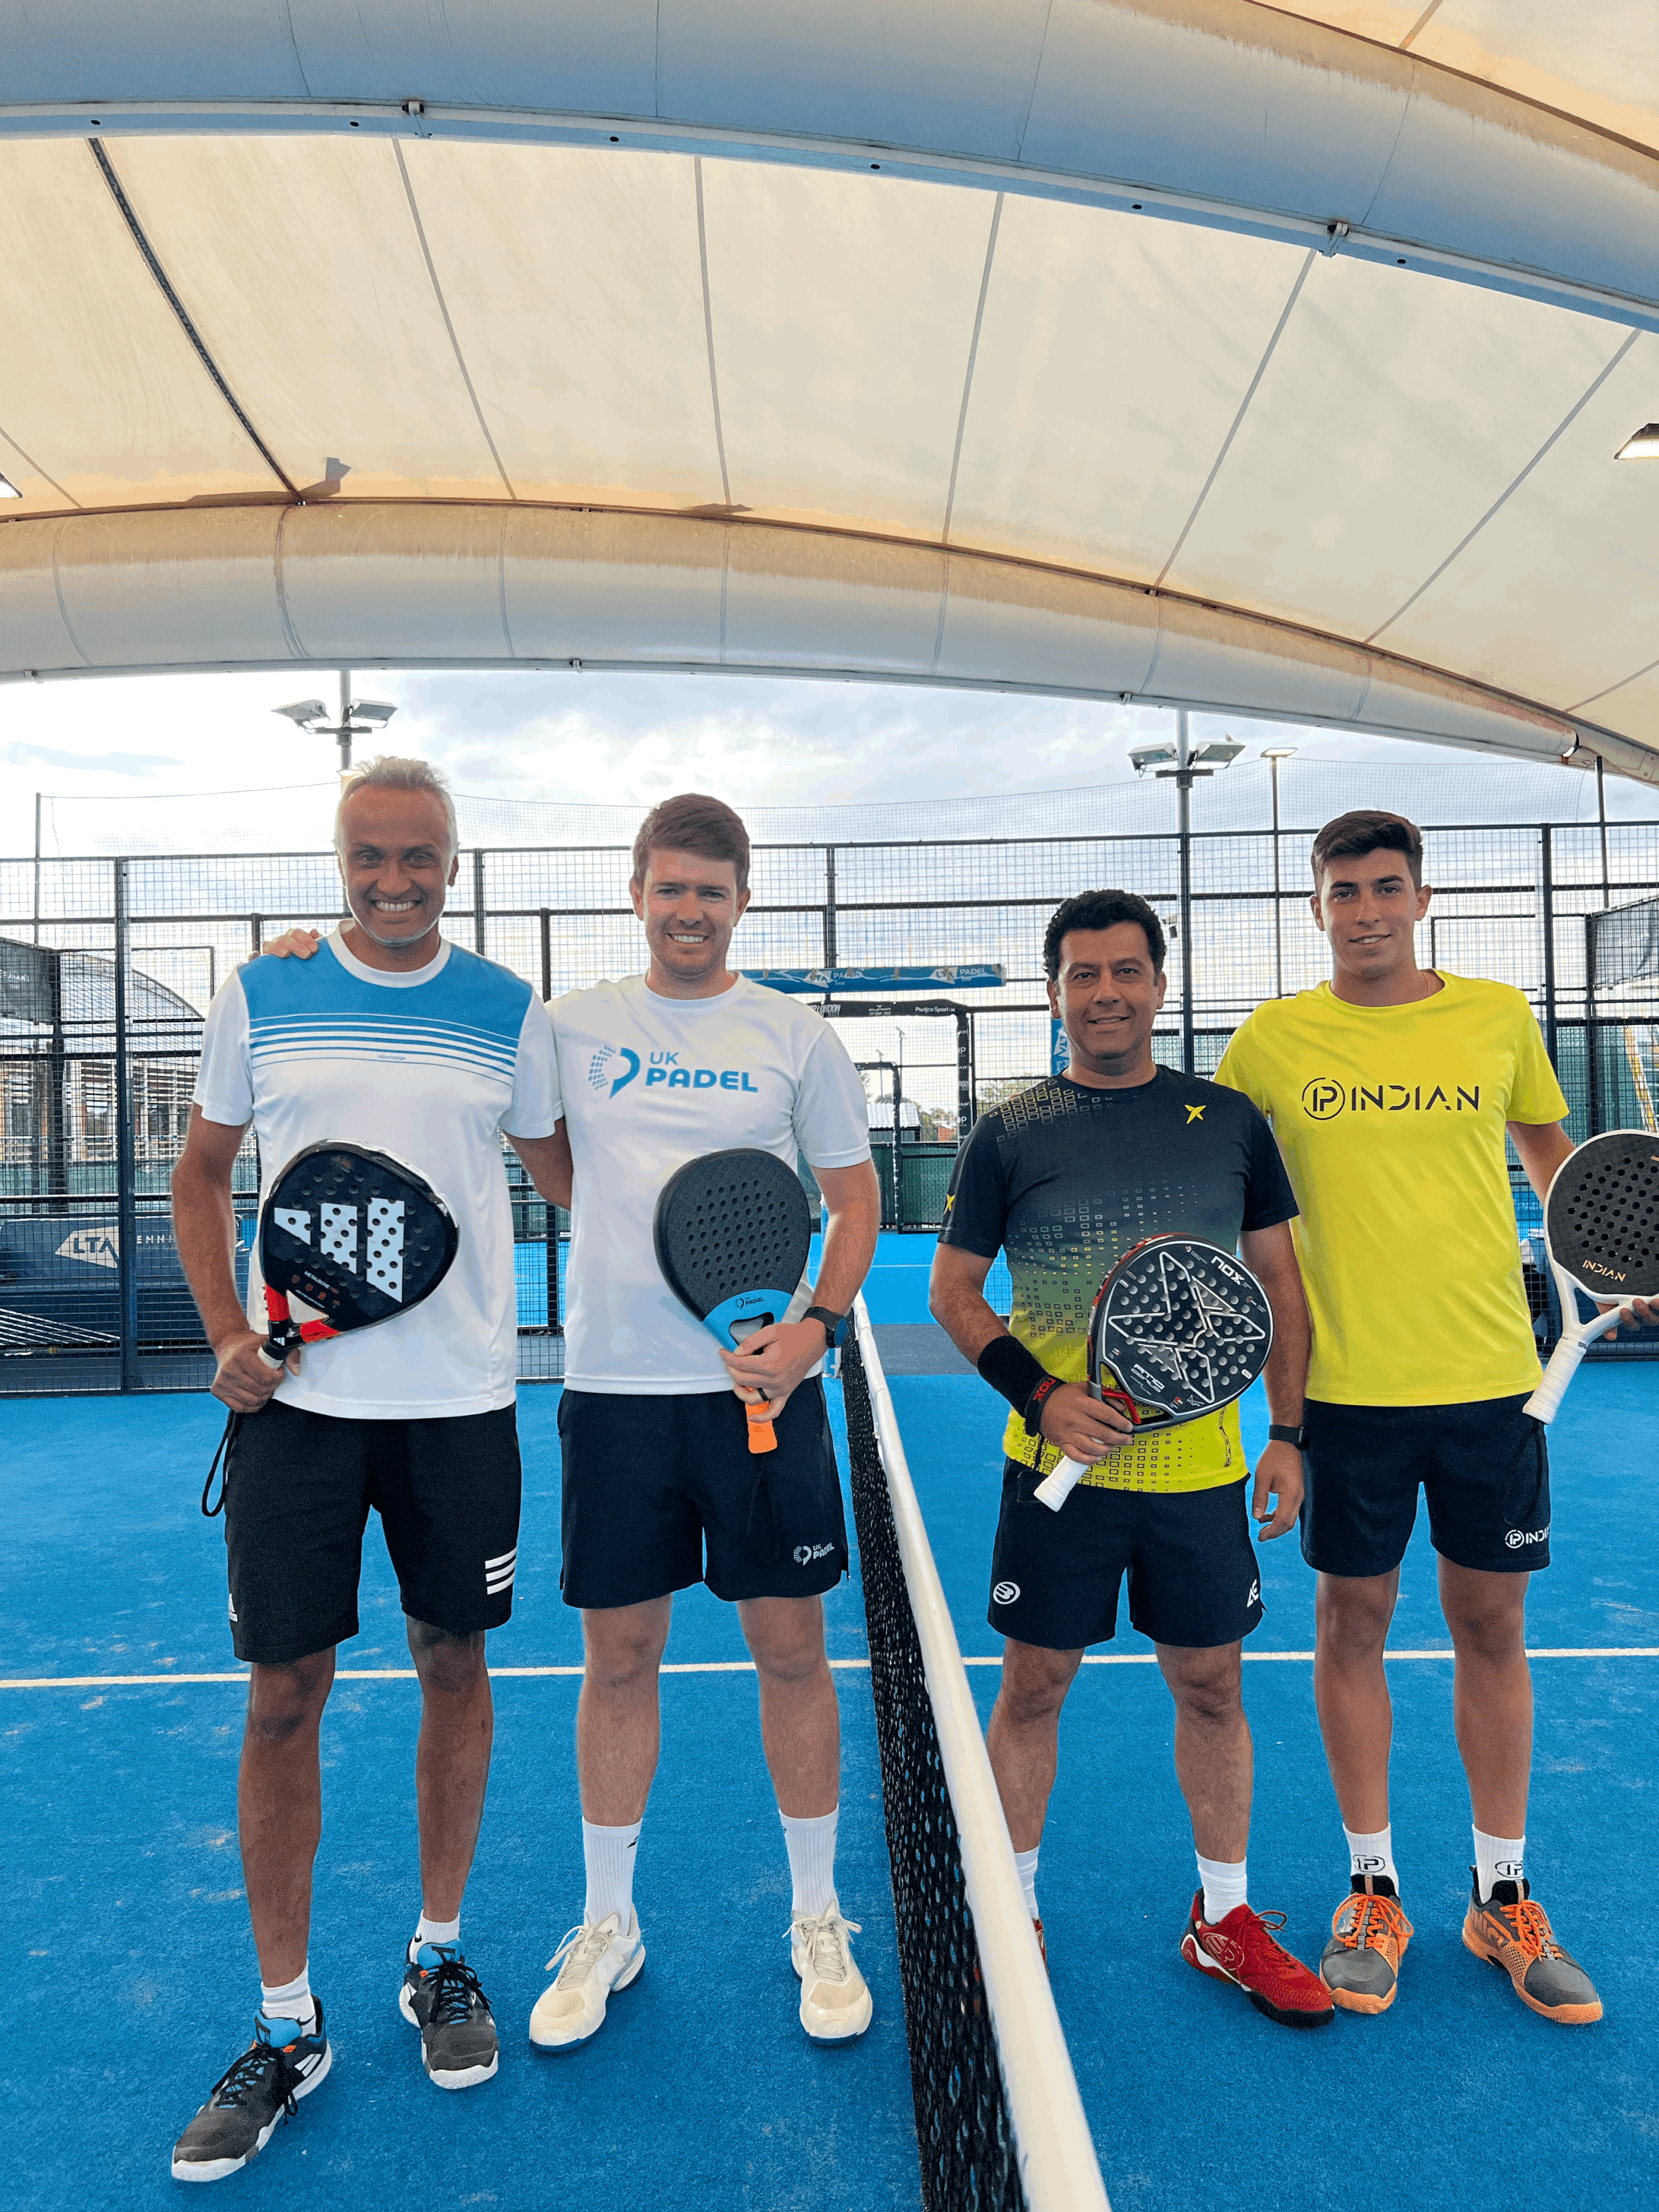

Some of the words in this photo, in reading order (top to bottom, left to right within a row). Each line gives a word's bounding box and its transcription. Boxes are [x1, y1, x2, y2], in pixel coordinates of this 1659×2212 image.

[816, 1004, 841, 1013] LONDON
[650, 1052, 680, 1065] UK
[644, 1067, 758, 1093] PADEL
[1351, 1084, 1480, 1112] INDIAN
[73, 1236, 120, 1262] LTA
[136, 1234, 171, 1244] ENNI
[1582, 1259, 1626, 1282] INDIAN
[745, 1297, 764, 1305] PADEL
[813, 1542, 835, 1560] PADEL
